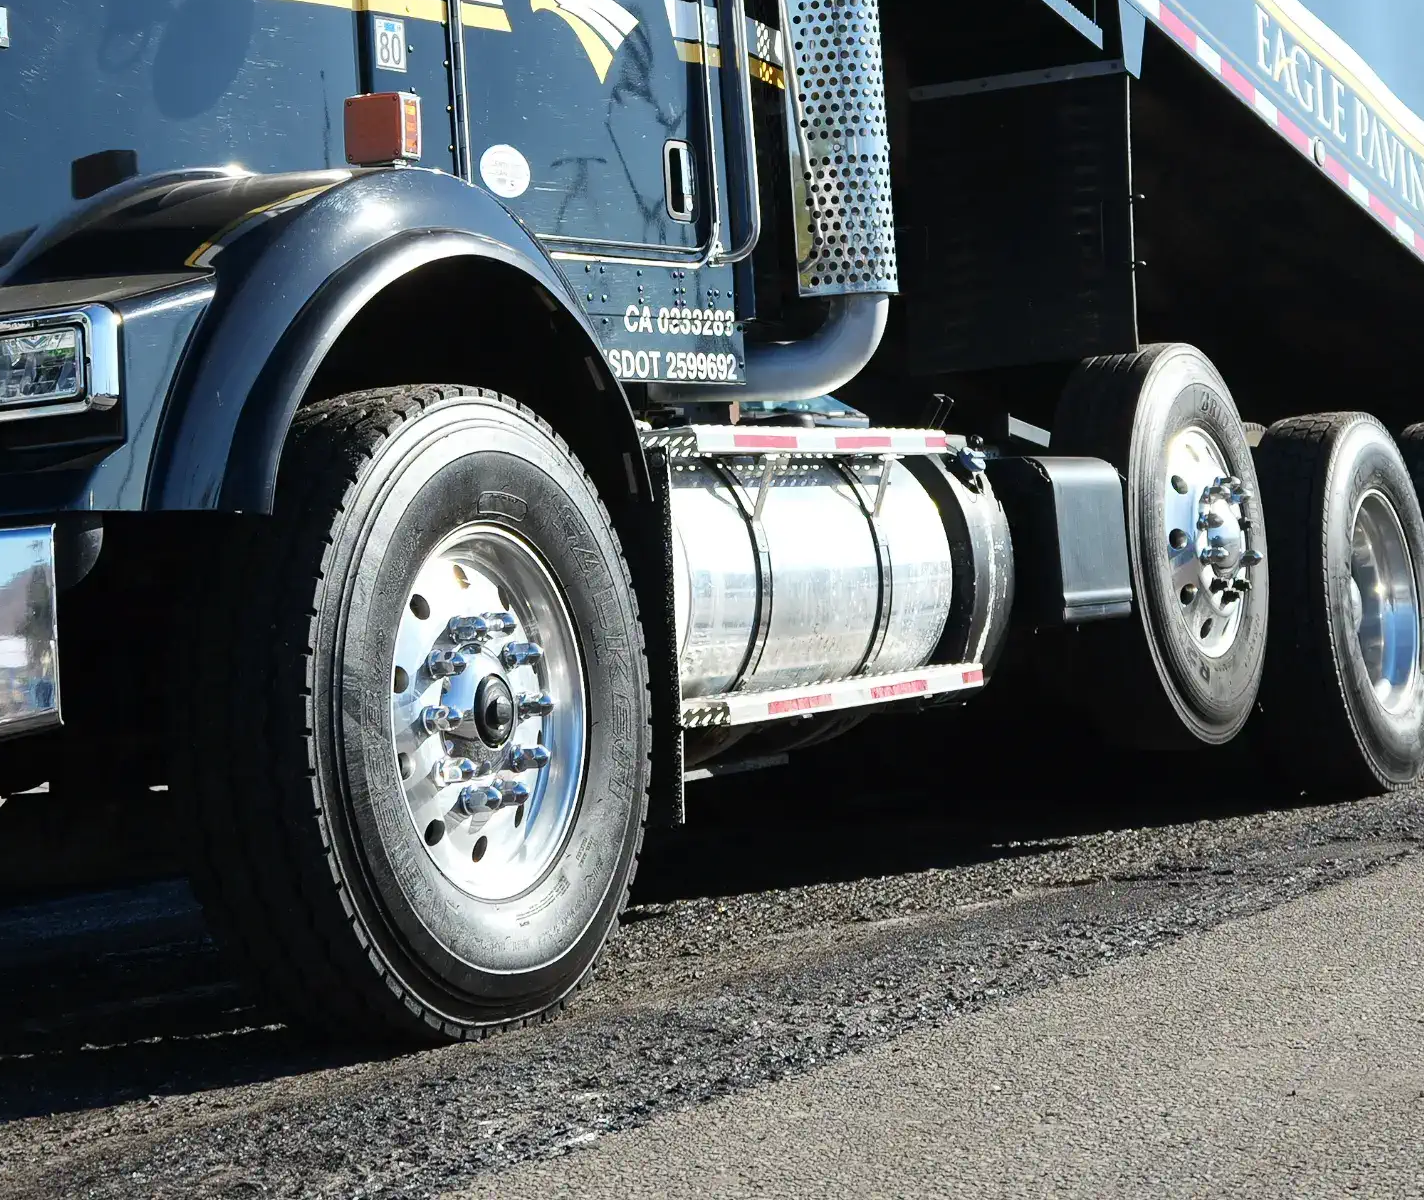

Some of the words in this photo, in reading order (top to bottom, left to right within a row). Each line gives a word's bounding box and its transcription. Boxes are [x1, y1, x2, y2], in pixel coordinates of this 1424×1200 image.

[380, 32, 402, 65] 80
[1255, 4, 1347, 144] EAGLE
[624, 304, 653, 333] CA
[603, 349, 661, 379] SDOT
[666, 351, 738, 381] 2599692
